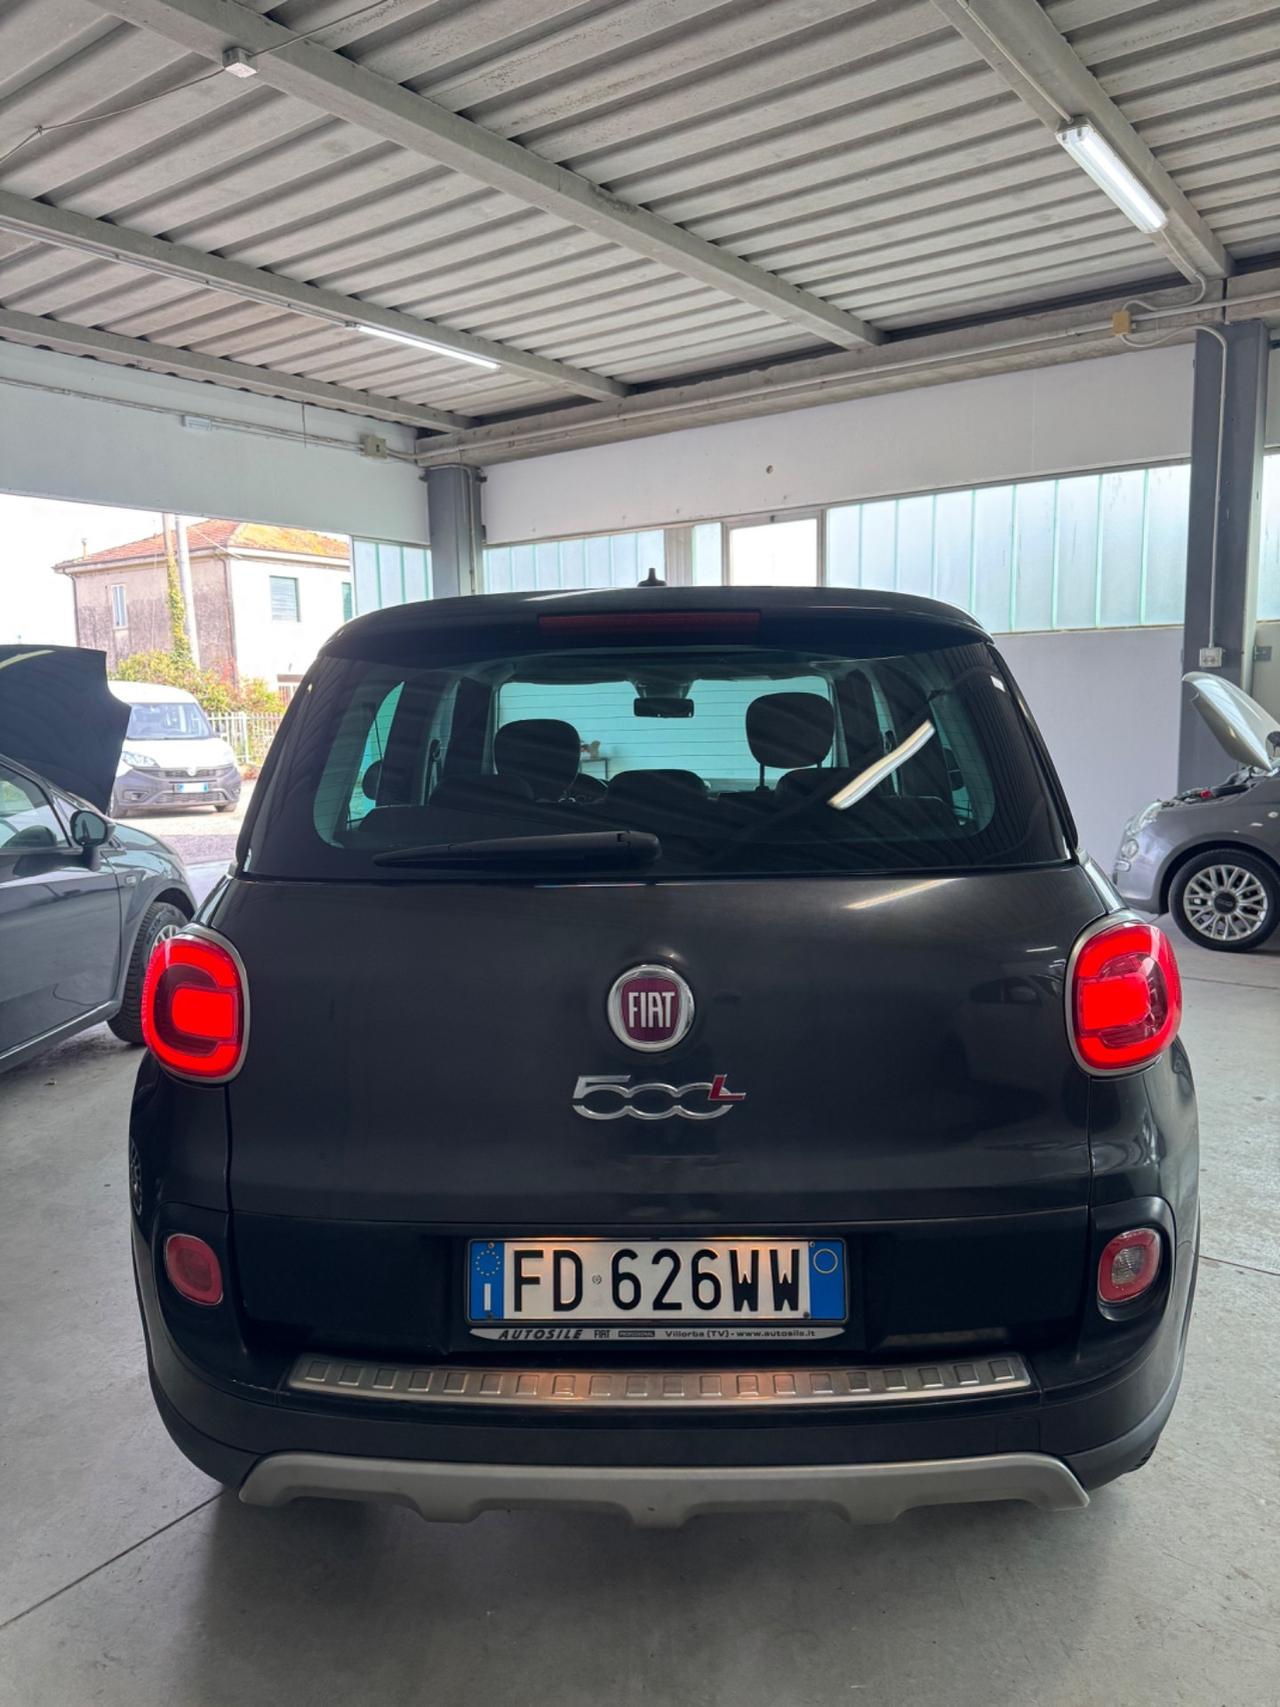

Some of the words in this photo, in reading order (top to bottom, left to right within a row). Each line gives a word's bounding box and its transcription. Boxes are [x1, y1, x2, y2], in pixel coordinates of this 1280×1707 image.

[628, 992, 675, 1028] FIAT
[513, 1249, 583, 1312] FD
[611, 1248, 800, 1312] 626WW
[498, 1329, 583, 1340] AUTOSILE
[665, 1330, 704, 1338] Villorba
